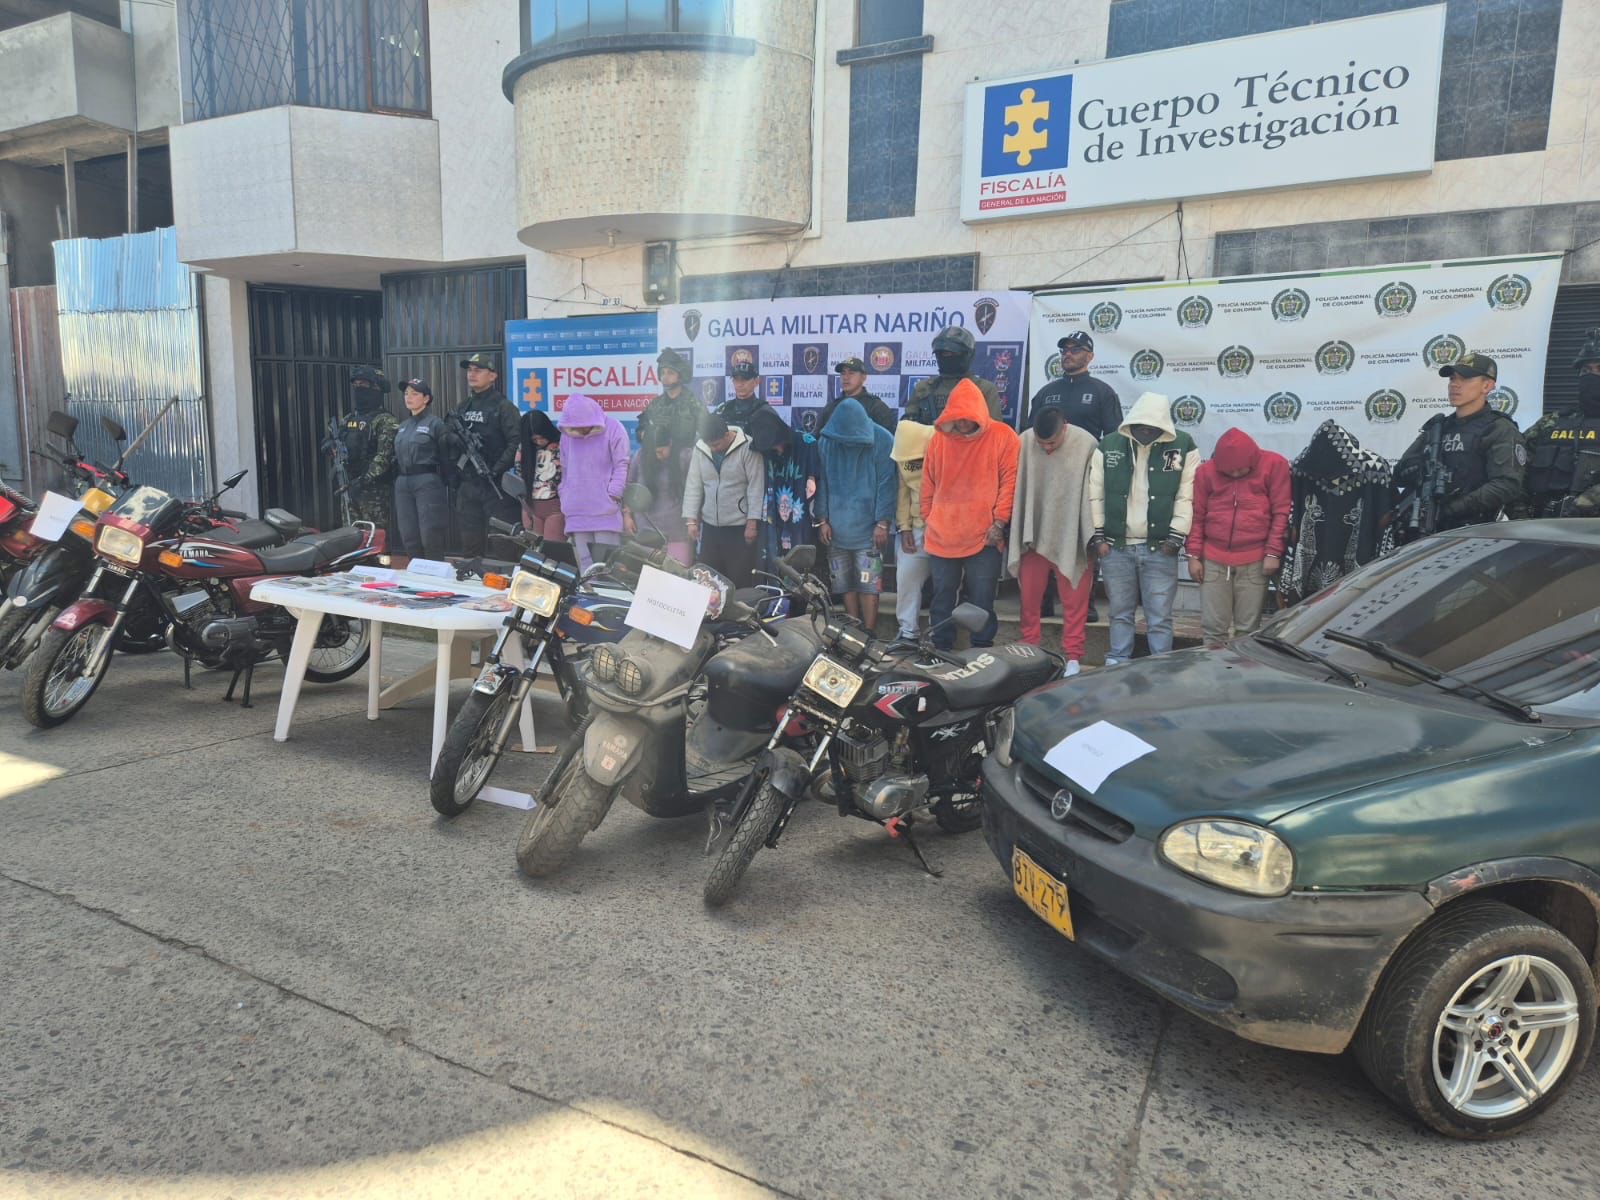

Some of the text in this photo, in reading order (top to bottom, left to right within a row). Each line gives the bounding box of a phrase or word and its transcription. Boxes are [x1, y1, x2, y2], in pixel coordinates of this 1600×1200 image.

[1078, 60, 1410, 131] Cuerpo Técnico
[1083, 99, 1399, 163] de Investigación
[980, 171, 1066, 195] FISCALÍA
[981, 199, 1014, 209] GENERAL
[1026, 196, 1036, 204] LA
[1036, 193, 1064, 203] NACIÓN
[708, 306, 965, 338] GAULA MILITAR NARIÑO
[762, 360, 790, 368] MILITAR
[905, 359, 937, 367] MILITAR
[553, 360, 659, 388] FISCALÍA
[793, 391, 823, 399] MILITAR
[871, 391, 896, 399] LITARES
[599, 396, 651, 409] DE LA NACIÓ
[179, 549, 209, 559] YAMAHA
[107, 563, 128, 575] YAMAHA
